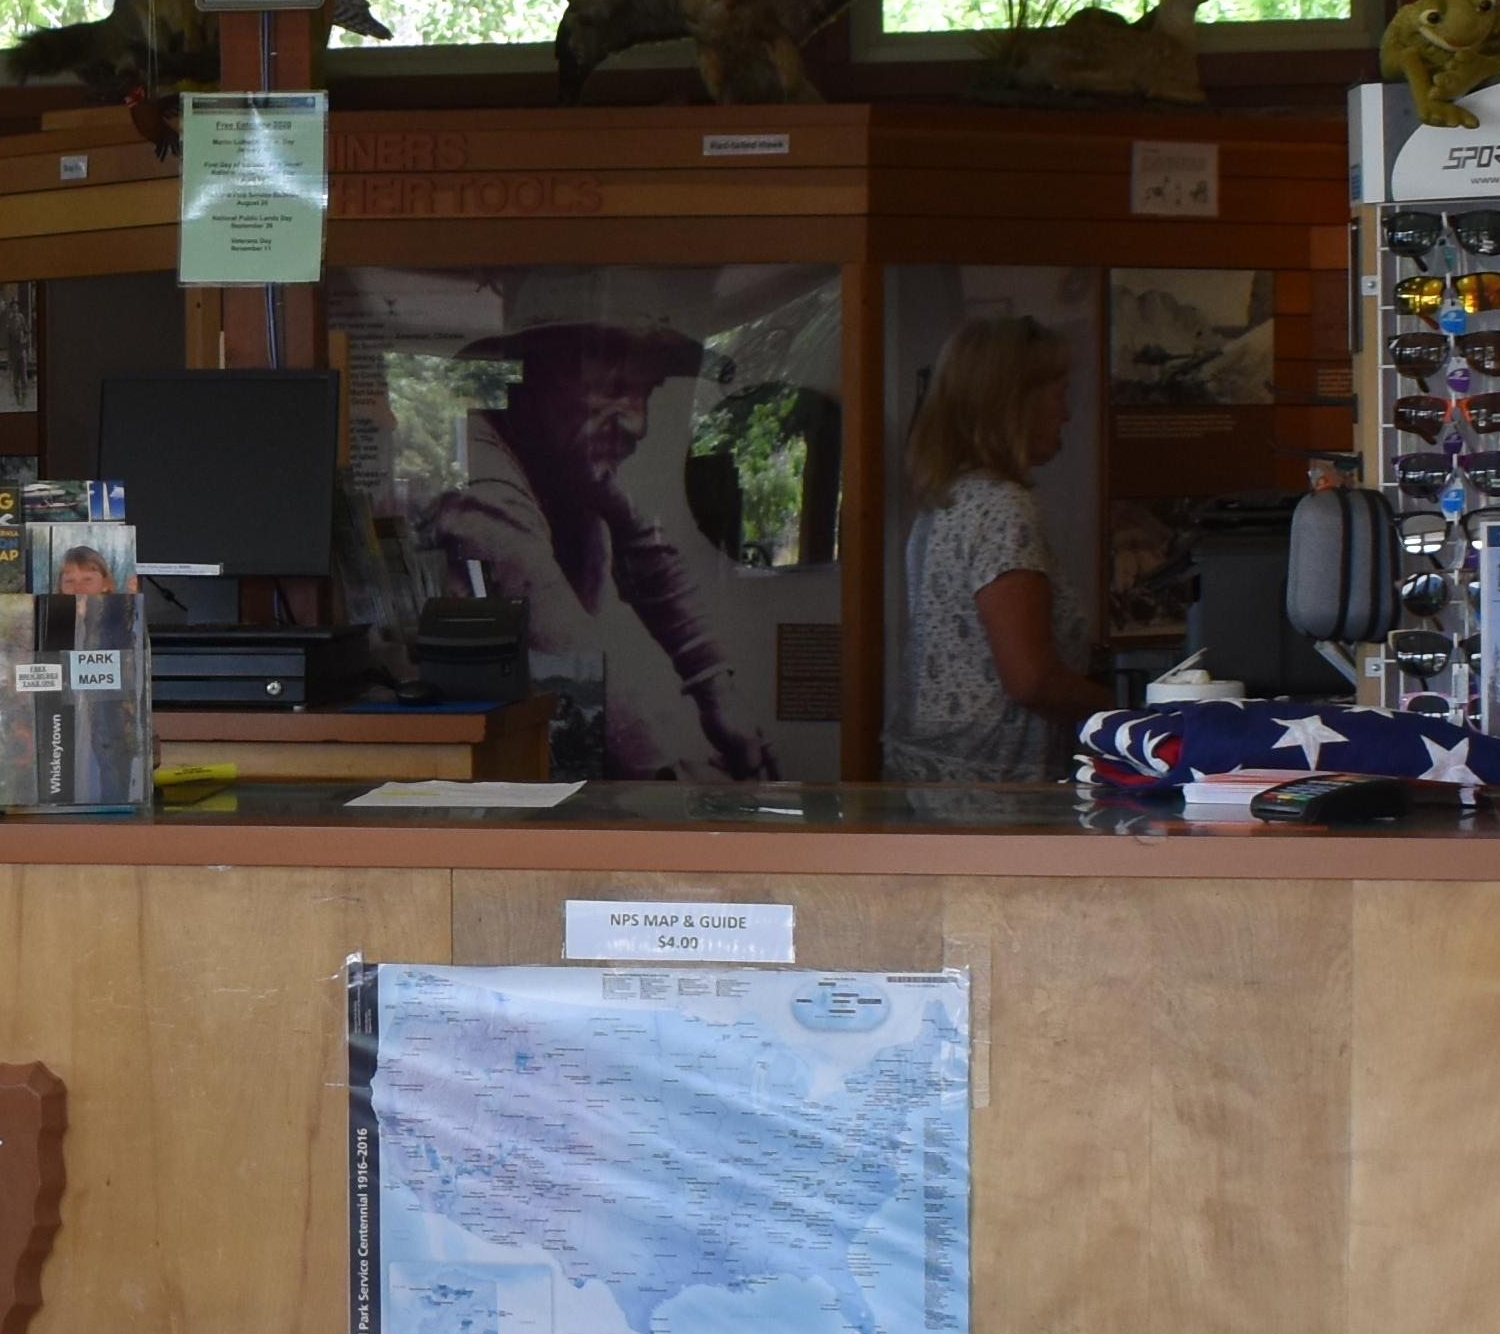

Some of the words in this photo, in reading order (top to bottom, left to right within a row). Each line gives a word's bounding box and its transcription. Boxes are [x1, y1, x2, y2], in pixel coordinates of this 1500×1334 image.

[330, 131, 469, 171] INERS
[331, 175, 439, 215] HEIR
[450, 176, 602, 215] TOOLS
[78, 653, 113, 665] PARK
[78, 673, 114, 685] MAPS
[51, 713, 62, 794] Whiskeytown
[610, 914, 639, 926] NPS
[644, 914, 678, 927] MAP
[682, 915, 695, 928] &
[699, 915, 747, 929] GUIDE
[658, 935, 698, 949] $4.00
[357, 1194, 368, 1261] Centennial
[357, 1265, 367, 1304] Service
[357, 1307, 367, 1334] Park
